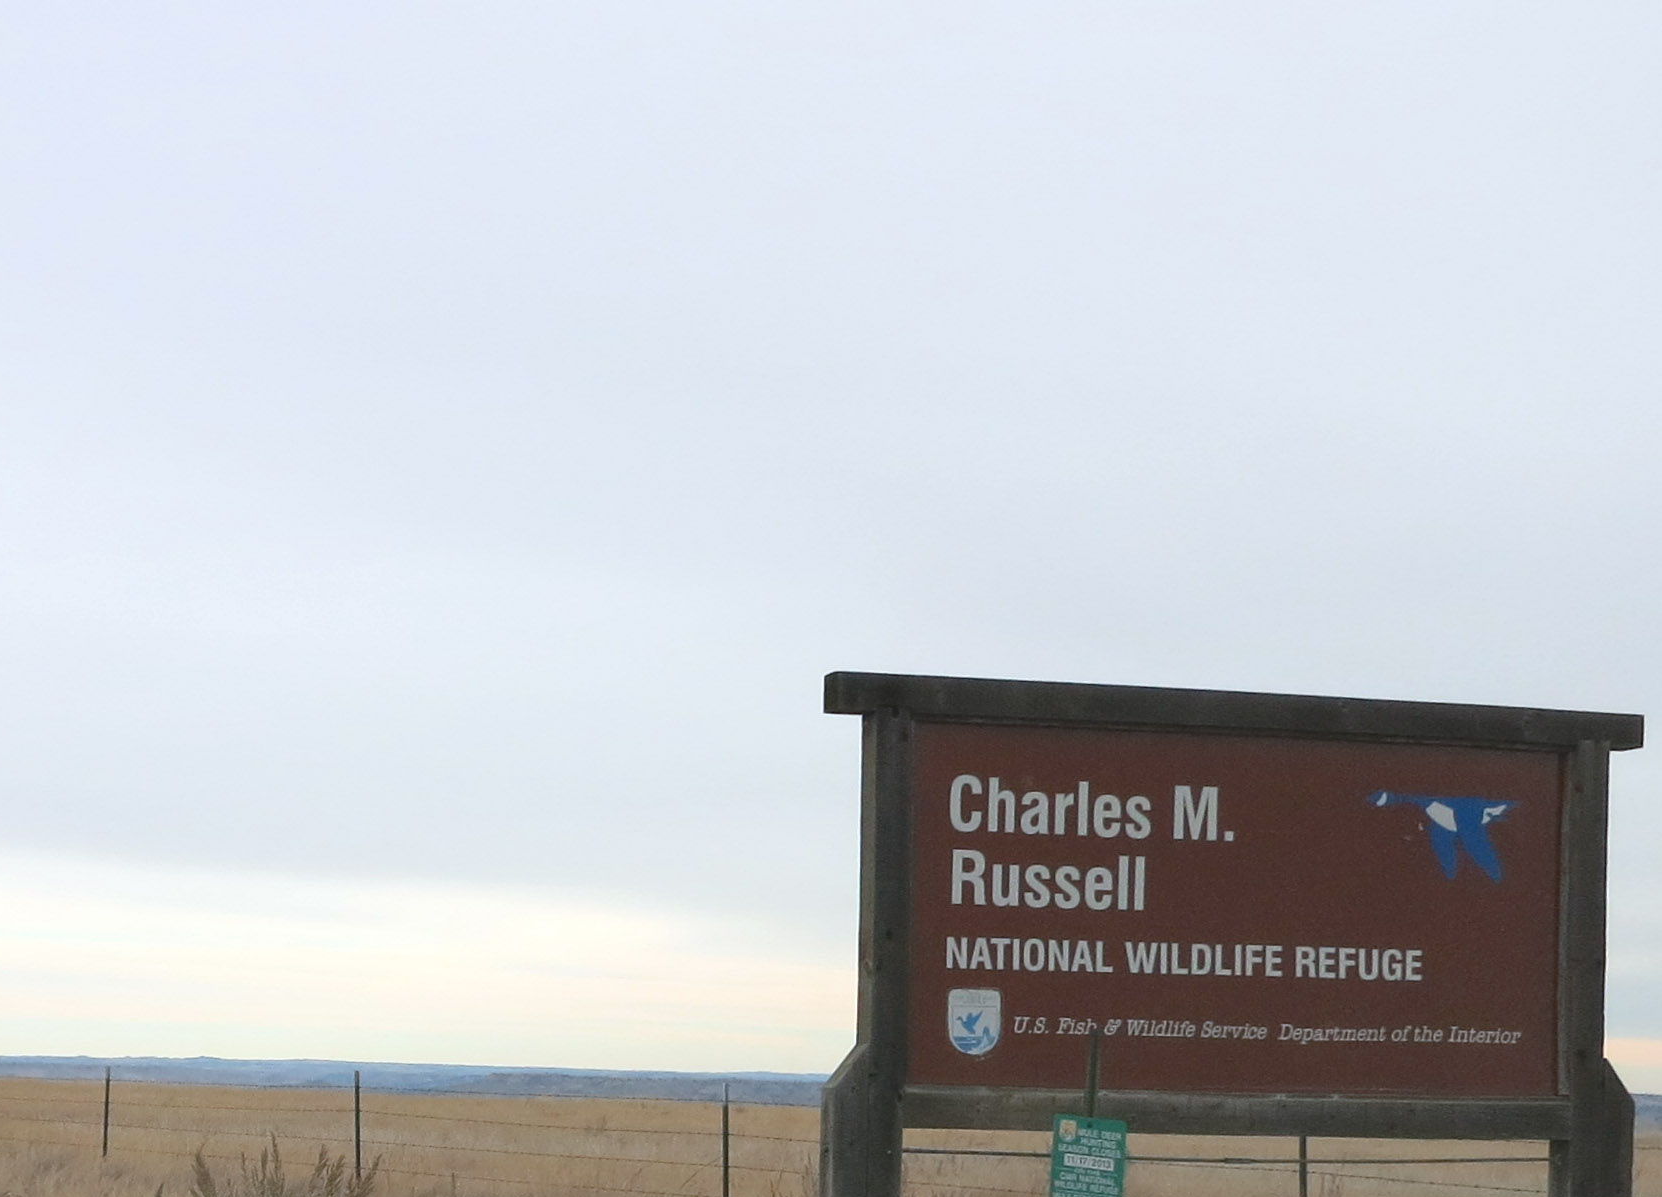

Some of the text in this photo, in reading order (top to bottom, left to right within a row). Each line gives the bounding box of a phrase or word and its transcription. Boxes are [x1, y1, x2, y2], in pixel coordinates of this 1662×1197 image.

[949, 774, 1234, 841] Charles M.
[951, 849, 1145, 911] Russell
[946, 936, 1423, 981] NATIONAL WILDLIFE REFUGE
[1013, 1016, 1521, 1044] U.S. Fish & Wildlife Service Department of the Interior
